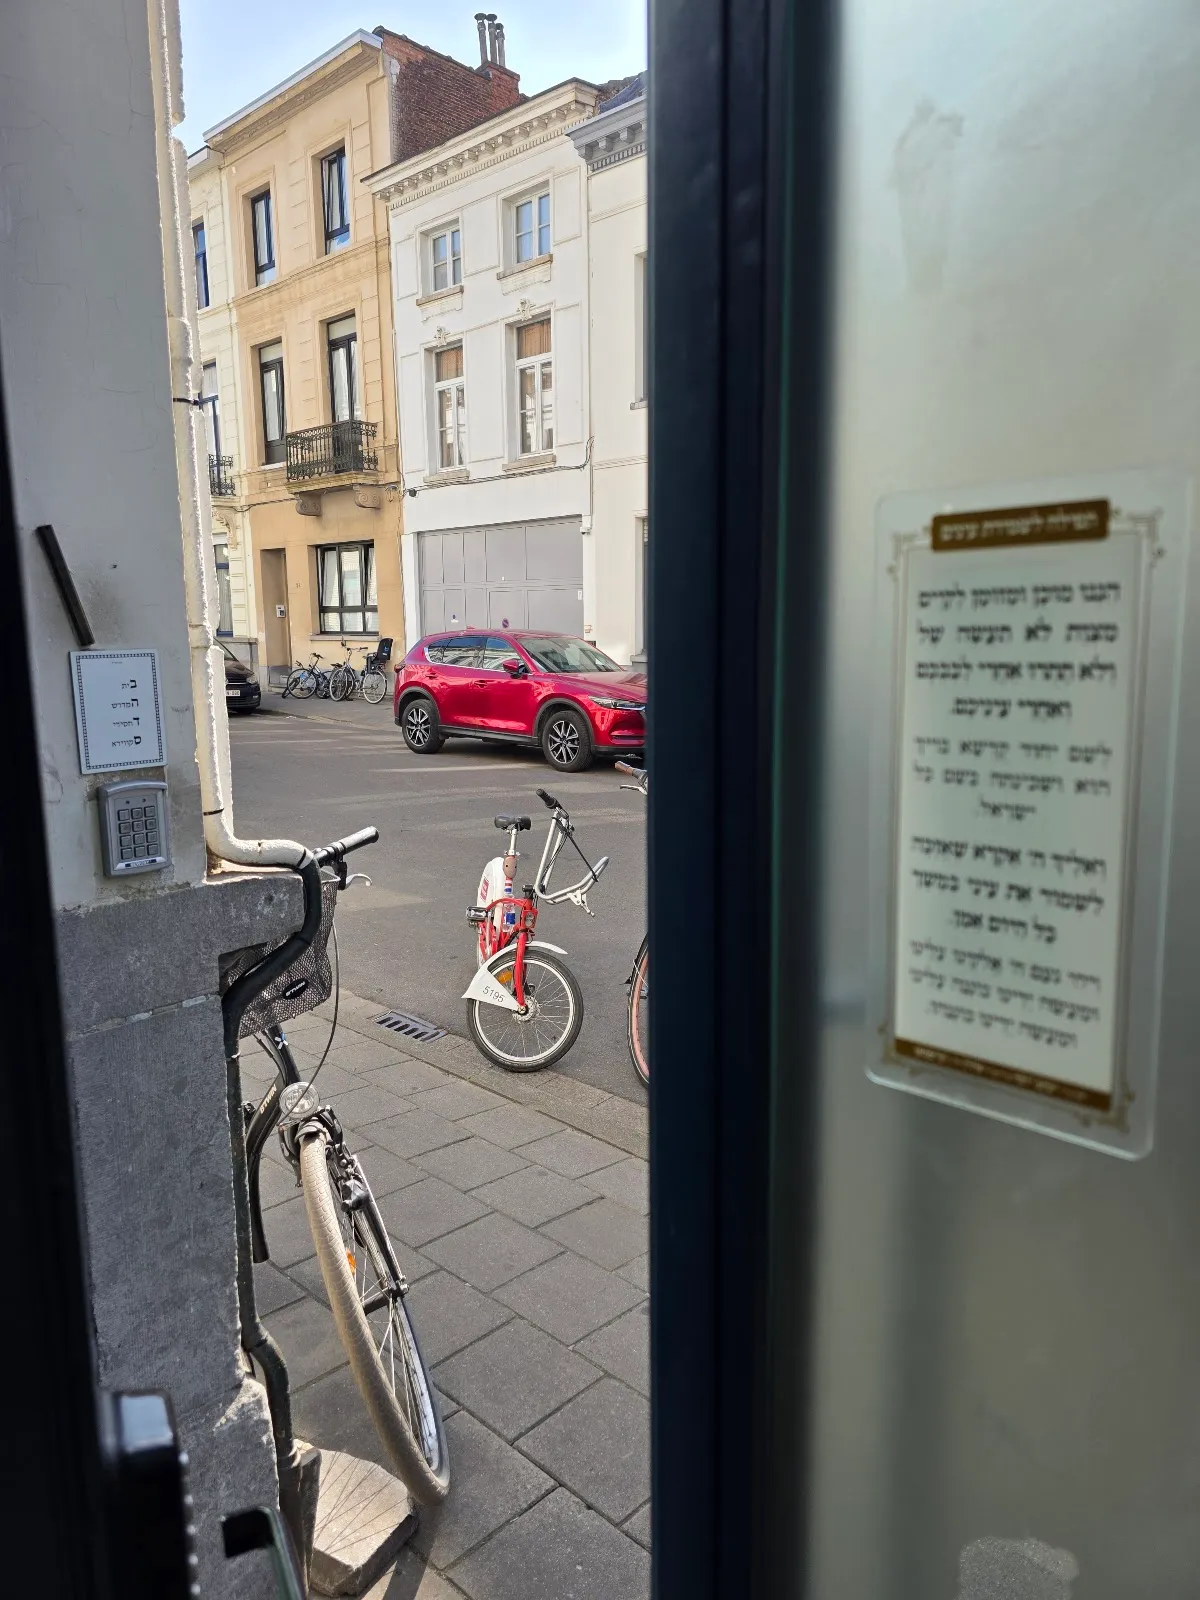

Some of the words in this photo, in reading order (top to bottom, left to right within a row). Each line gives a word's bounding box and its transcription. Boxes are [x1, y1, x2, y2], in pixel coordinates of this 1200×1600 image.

[121, 679, 138, 690] בית
[111, 698, 139, 709] המדרש
[482, 985, 506, 1003] 5195
